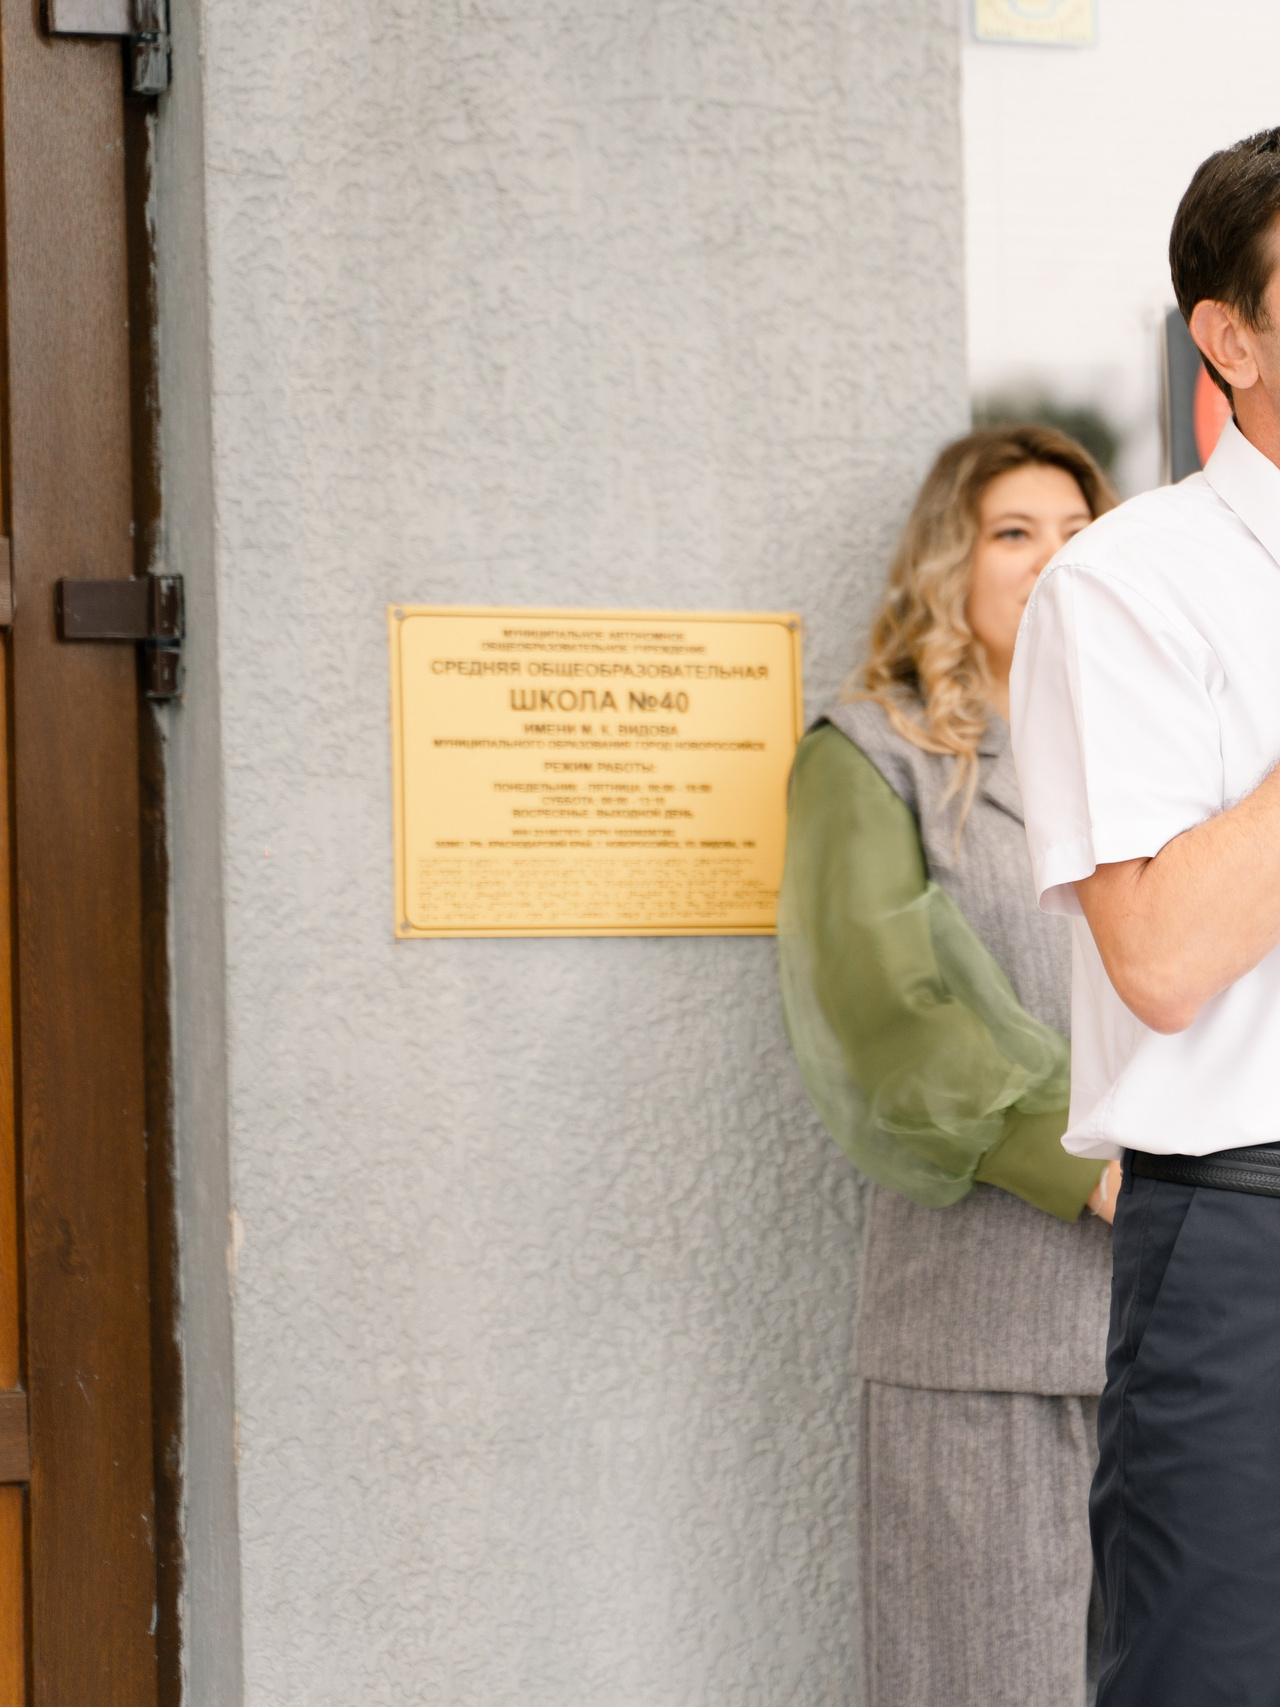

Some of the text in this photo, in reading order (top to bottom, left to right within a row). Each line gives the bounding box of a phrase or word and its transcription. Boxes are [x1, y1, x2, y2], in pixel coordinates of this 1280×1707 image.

[503, 629, 685, 641] МУНИЦИПАЛЬНОЕ АВТОНОМНОЕ
[481, 642, 627, 653] ОБЩЕОБРАЗОВАТЕЛЬНОЕ
[430, 660, 769, 680] СРЕДНЯЯ ОБЩЕОБРАЗОВАТЕЛЬНАЯ
[509, 688, 690, 714] ШКОЛА №40
[524, 723, 576, 735] ИМЕНИ
[618, 724, 679, 738] ВИДОВА
[433, 738, 544, 750] МУНИЦИПАЛЬНОГО
[549, 740, 631, 751] ОБРАЗОВАНИЯ
[675, 740, 766, 751] НОВОРОССИЙСК
[544, 761, 593, 773] РЕЖИМ
[493, 782, 577, 793] ПОНЕДЕЛЬНИК
